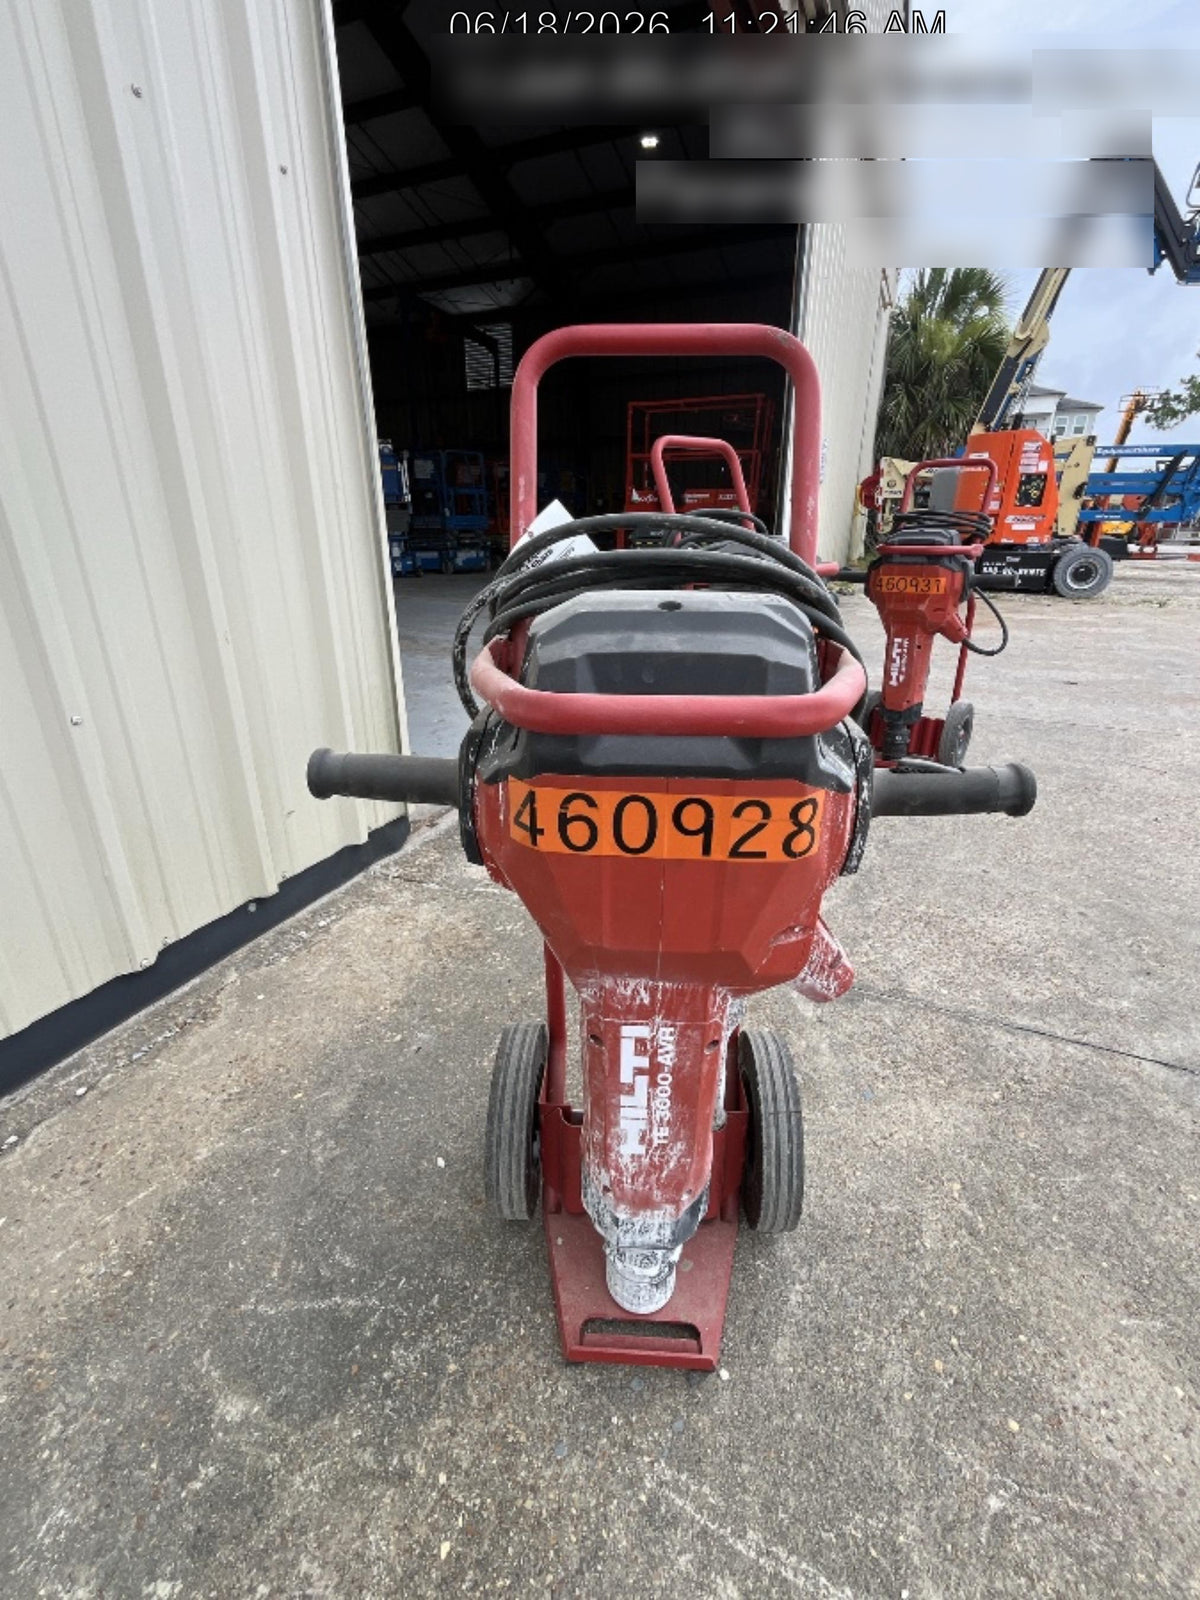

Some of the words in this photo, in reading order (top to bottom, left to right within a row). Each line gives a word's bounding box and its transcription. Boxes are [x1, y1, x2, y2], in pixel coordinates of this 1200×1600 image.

[889, 637, 902, 687] HILTI
[513, 789, 819, 859] 460928
[619, 1025, 650, 1155] HILTI
[655, 1027, 676, 1123] 3000-AVR
